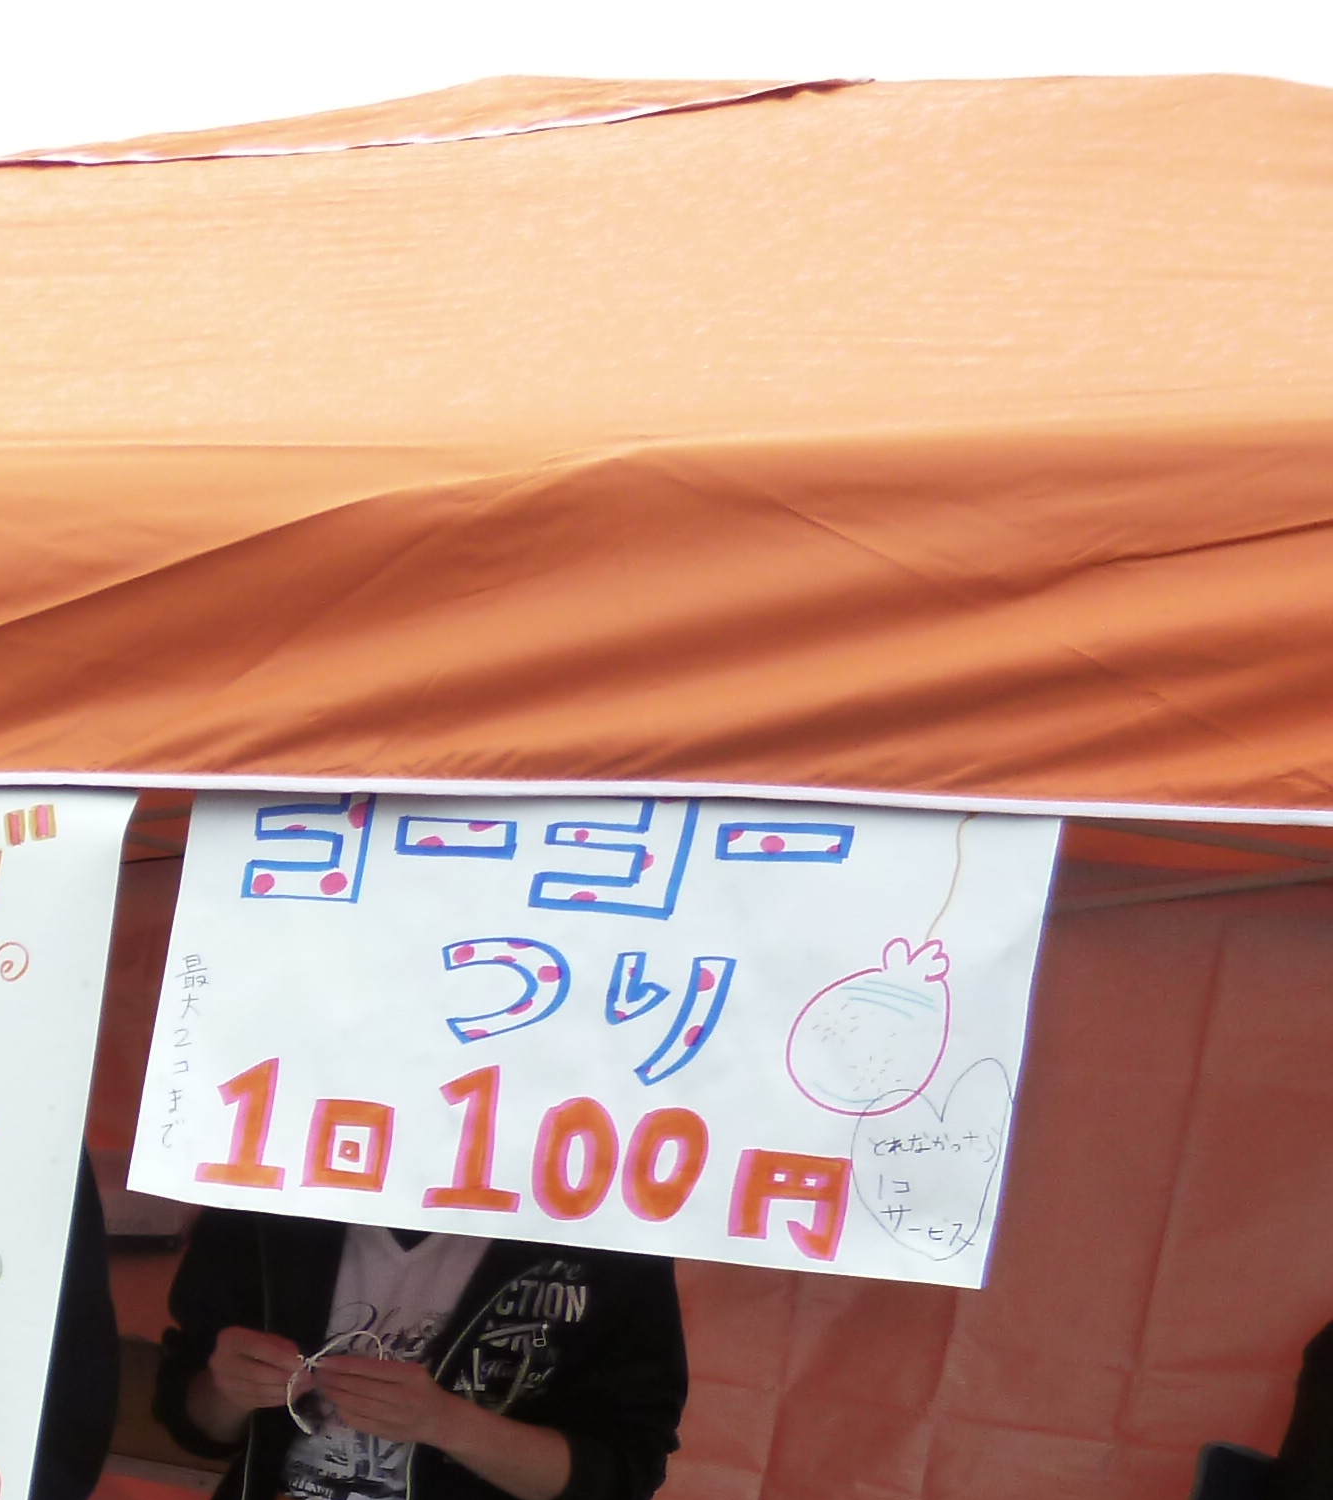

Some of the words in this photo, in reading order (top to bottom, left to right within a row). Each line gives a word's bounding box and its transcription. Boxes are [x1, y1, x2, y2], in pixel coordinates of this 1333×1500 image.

[241, 795, 855, 919] ヨーヨー
[442, 936, 736, 1085] つり
[194, 1057, 853, 1261] 1回100円
[868, 1131, 1000, 1163] とれなかったら
[879, 1209, 976, 1249] サービス
